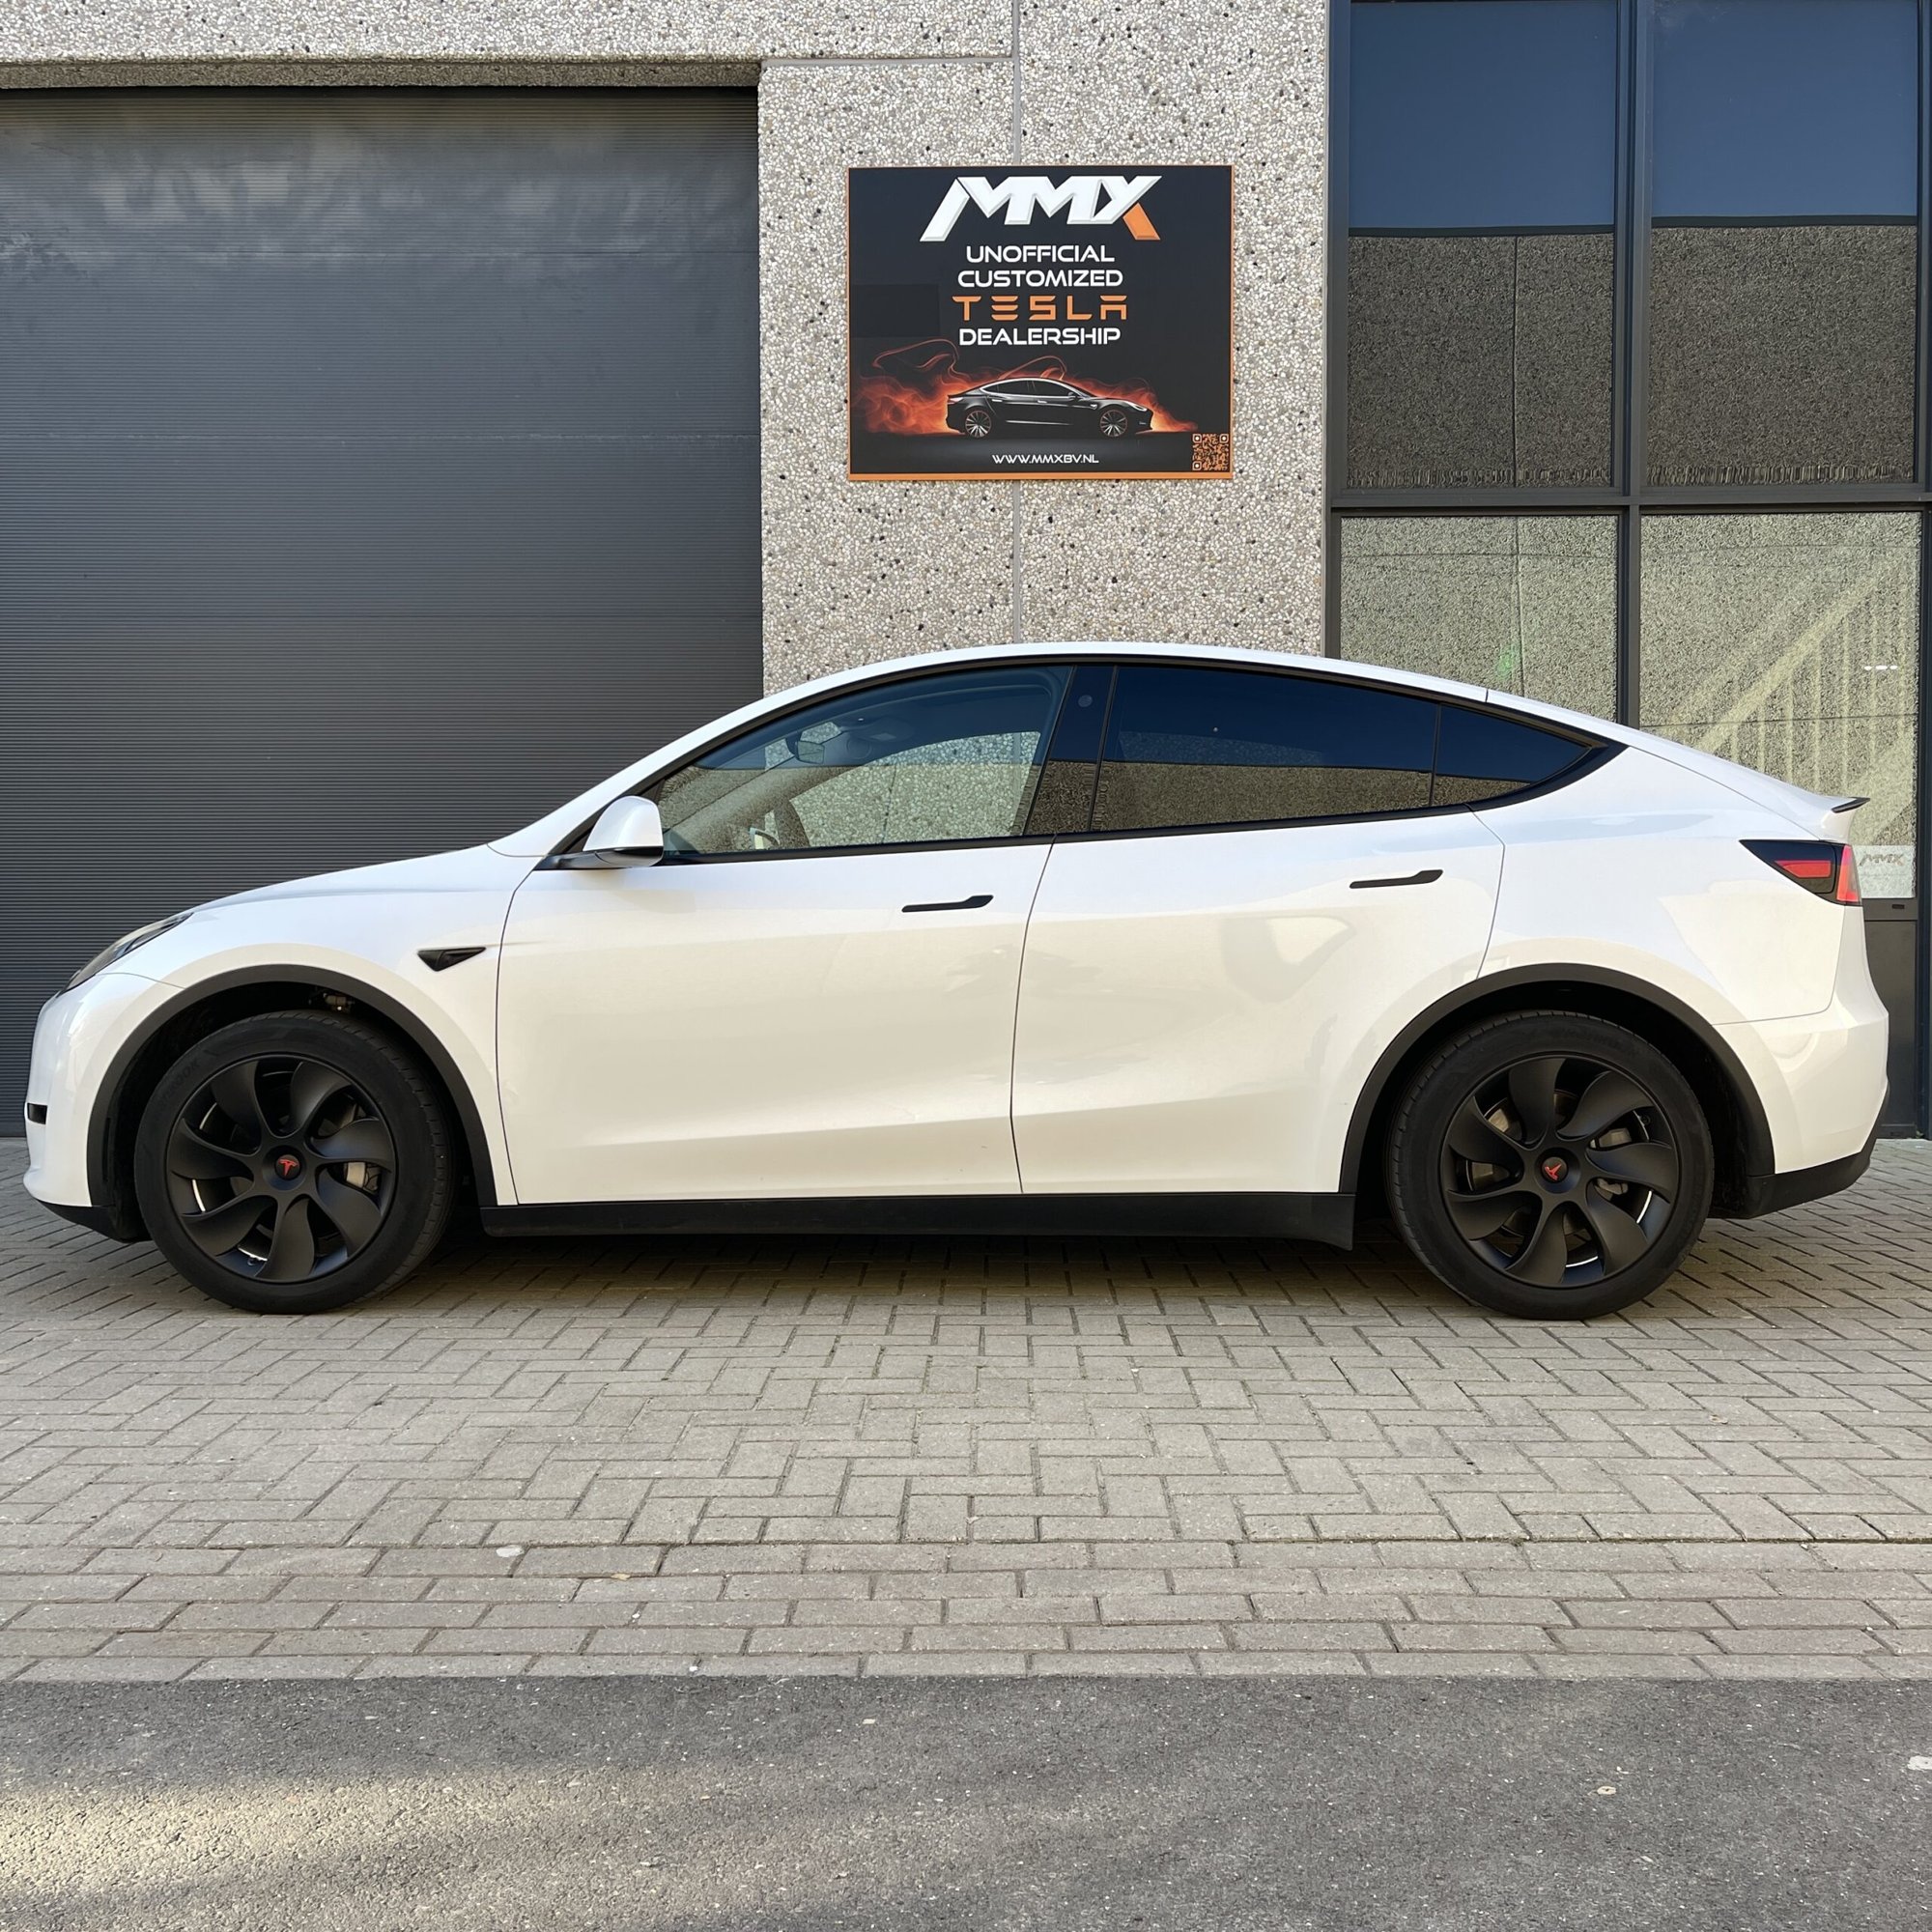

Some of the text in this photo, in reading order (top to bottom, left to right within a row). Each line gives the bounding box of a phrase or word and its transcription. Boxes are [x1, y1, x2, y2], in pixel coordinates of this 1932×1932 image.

[920, 176, 1162, 242] MMX
[966, 244, 1116, 264] UNOFFICIAL
[957, 270, 1123, 288] CUSTOMIZED
[952, 295, 1127, 322] TESLA
[959, 327, 1122, 346] DEALERSHIP
[991, 454, 1099, 465] WWW.MMXBV.NL
